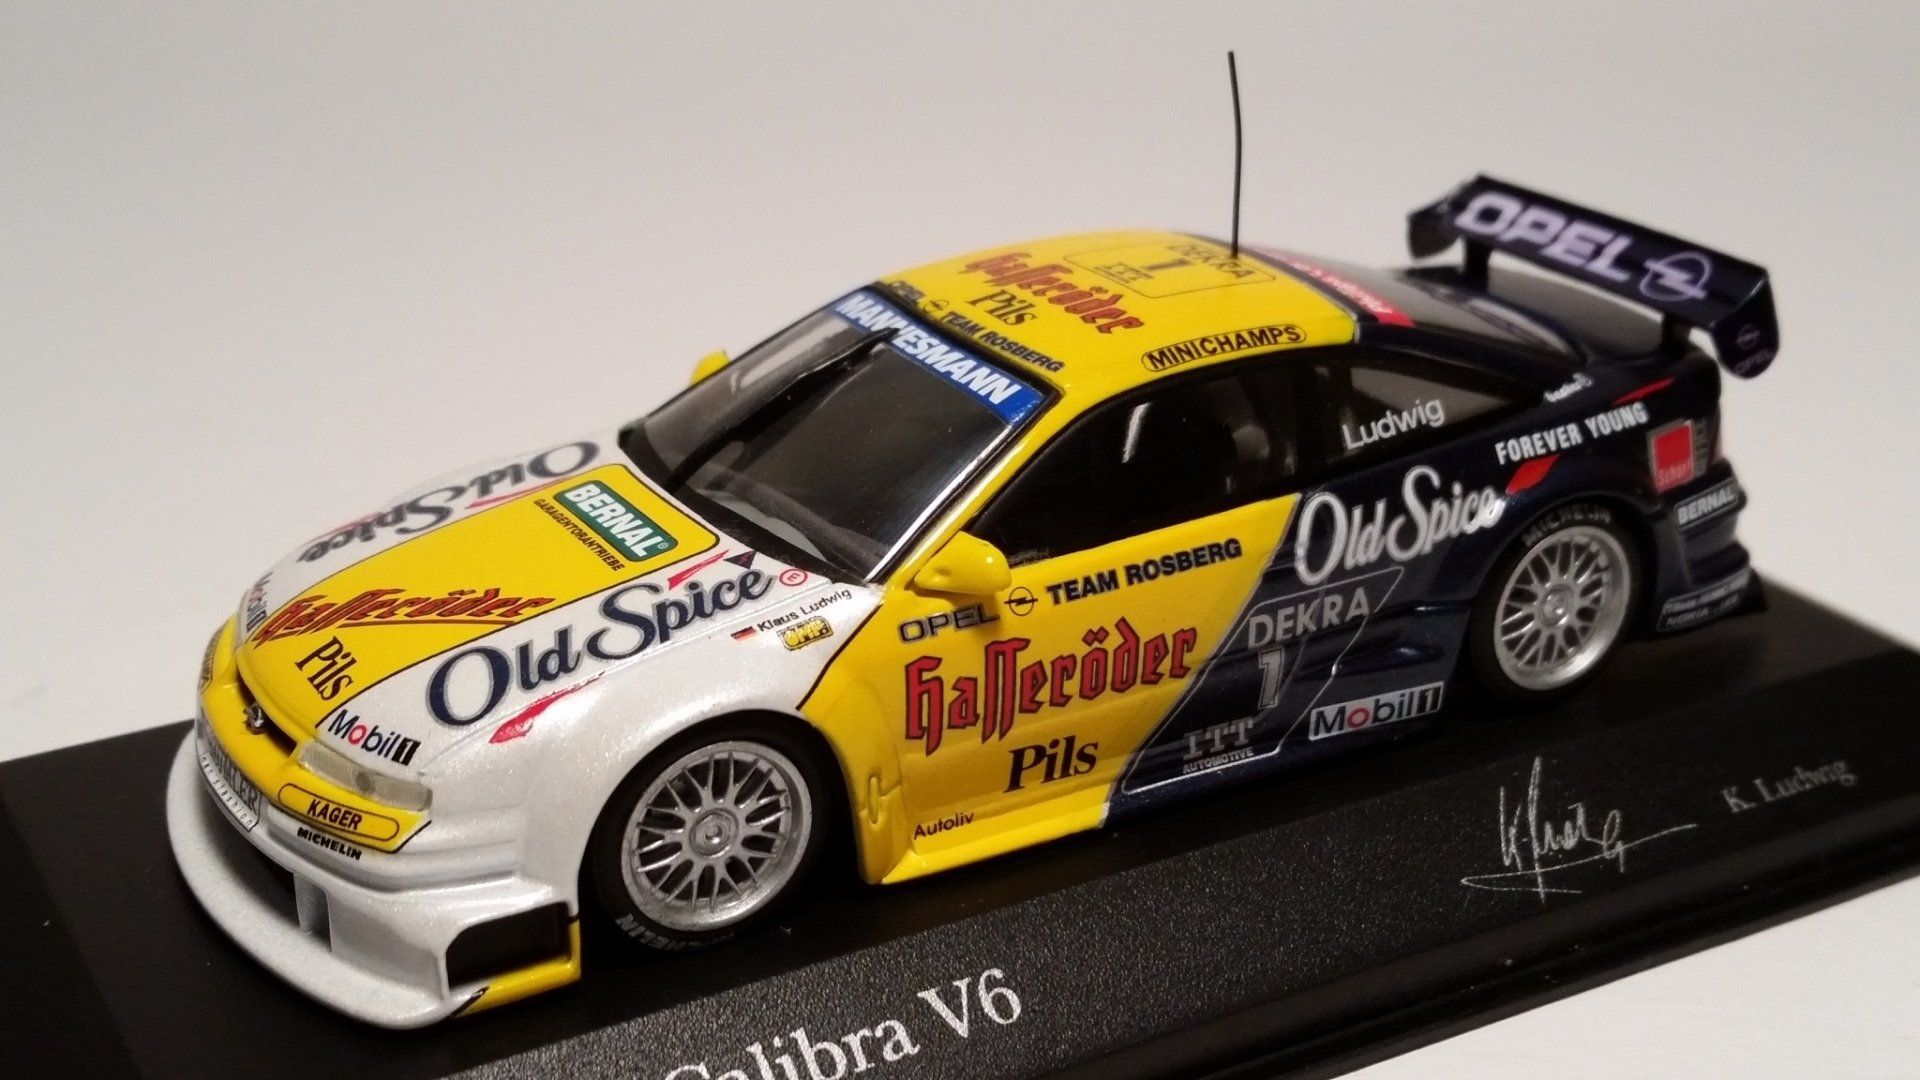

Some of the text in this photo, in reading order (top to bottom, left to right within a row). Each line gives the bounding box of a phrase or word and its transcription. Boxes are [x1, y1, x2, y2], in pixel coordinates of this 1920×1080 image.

[1455, 191, 1634, 282] OPEL
[968, 289, 1038, 326] Pils
[940, 311, 986, 338] TEAM
[979, 330, 1066, 372] ROSBERG
[1146, 325, 1301, 370] MINICHAMPS
[1342, 399, 1445, 450] Ludwig
[1494, 400, 1650, 465] FOREVER YOUNG
[467, 441, 600, 498] Old
[533, 498, 626, 572] GARAGENTORANTRIEBE
[1295, 465, 1508, 586] Old Spice
[1677, 486, 1736, 526] BERNAL
[757, 589, 853, 632] Klaus Ludwig
[899, 537, 1244, 644] OPEL TEAM ROSBERG
[1248, 587, 1371, 651] DEKRA
[294, 635, 357, 701] Pils
[426, 569, 778, 729] Old Spice
[1256, 645, 1285, 711] 1
[1002, 734, 1099, 793] Pils
[1182, 748, 1255, 775] AUTOMOTIVE
[1183, 716, 1255, 760] ITT
[297, 826, 362, 860] MICHELIN
[307, 798, 363, 831] KAGER
[914, 810, 974, 840] Autoliv
[917, 968, 1022, 1039] V6
